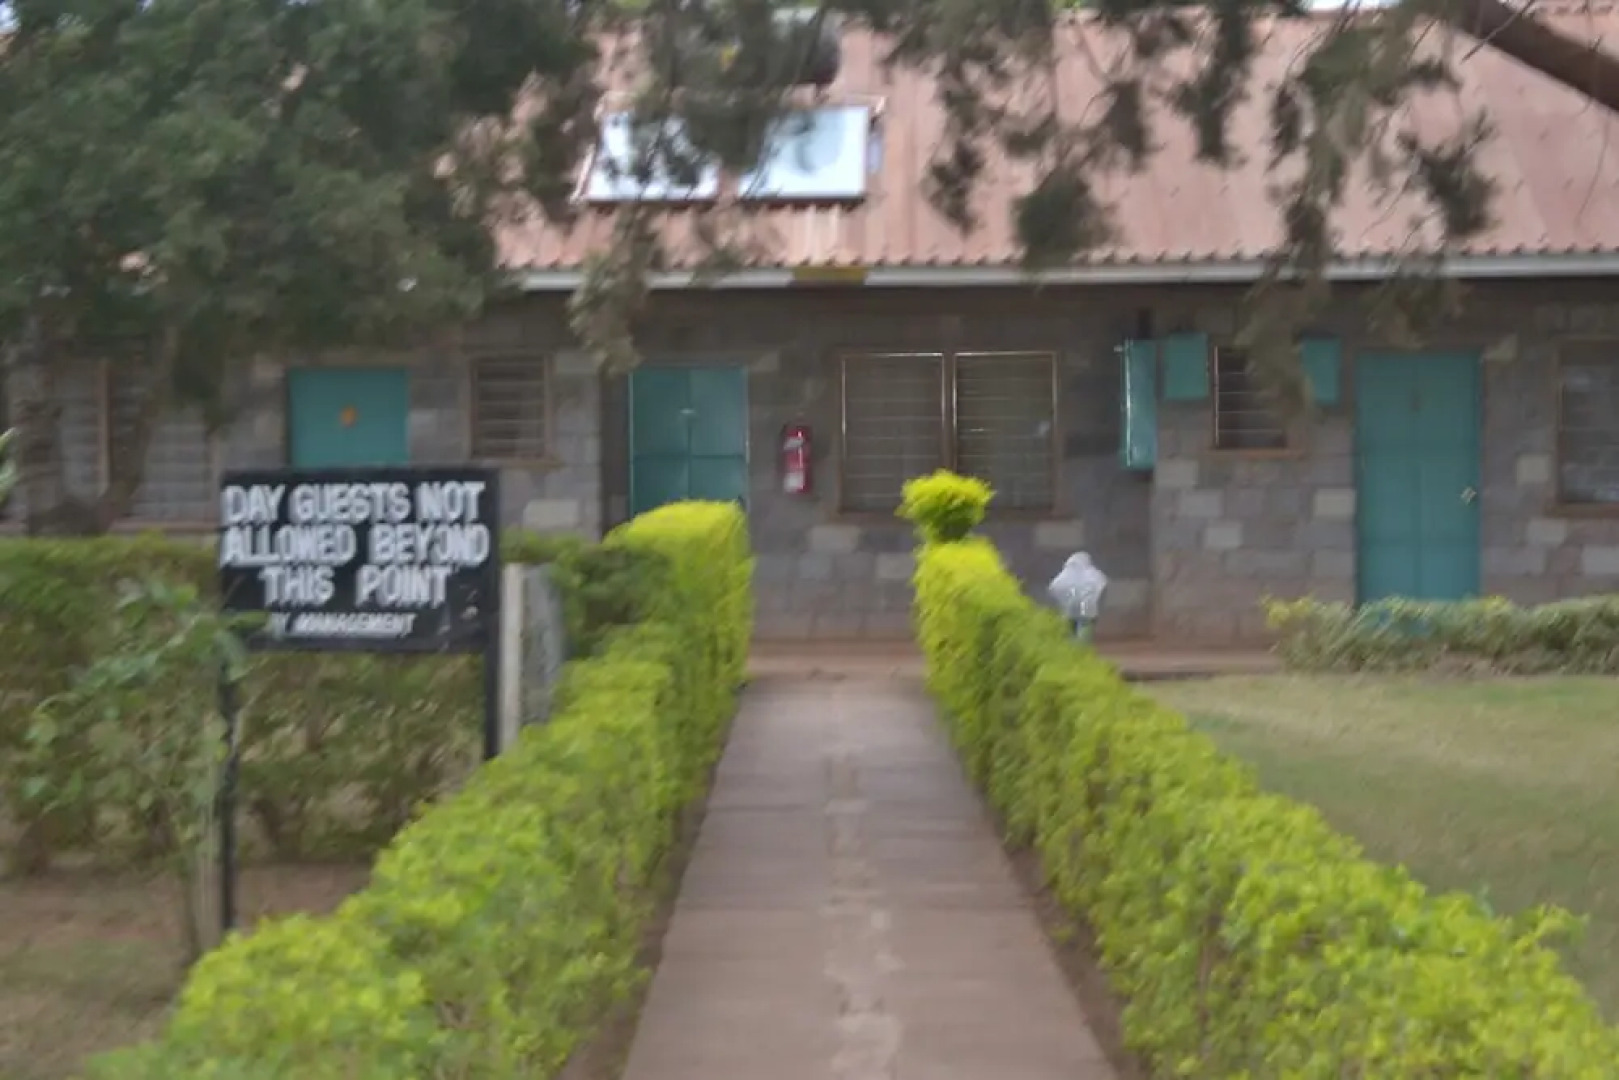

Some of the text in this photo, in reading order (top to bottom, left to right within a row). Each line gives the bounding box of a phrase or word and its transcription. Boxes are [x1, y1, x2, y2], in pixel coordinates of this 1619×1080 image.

[221, 481, 486, 524] DAY GUESTS NOT
[220, 523, 490, 567] ALLOWED BEYOND
[259, 564, 449, 607] THIS POINT
